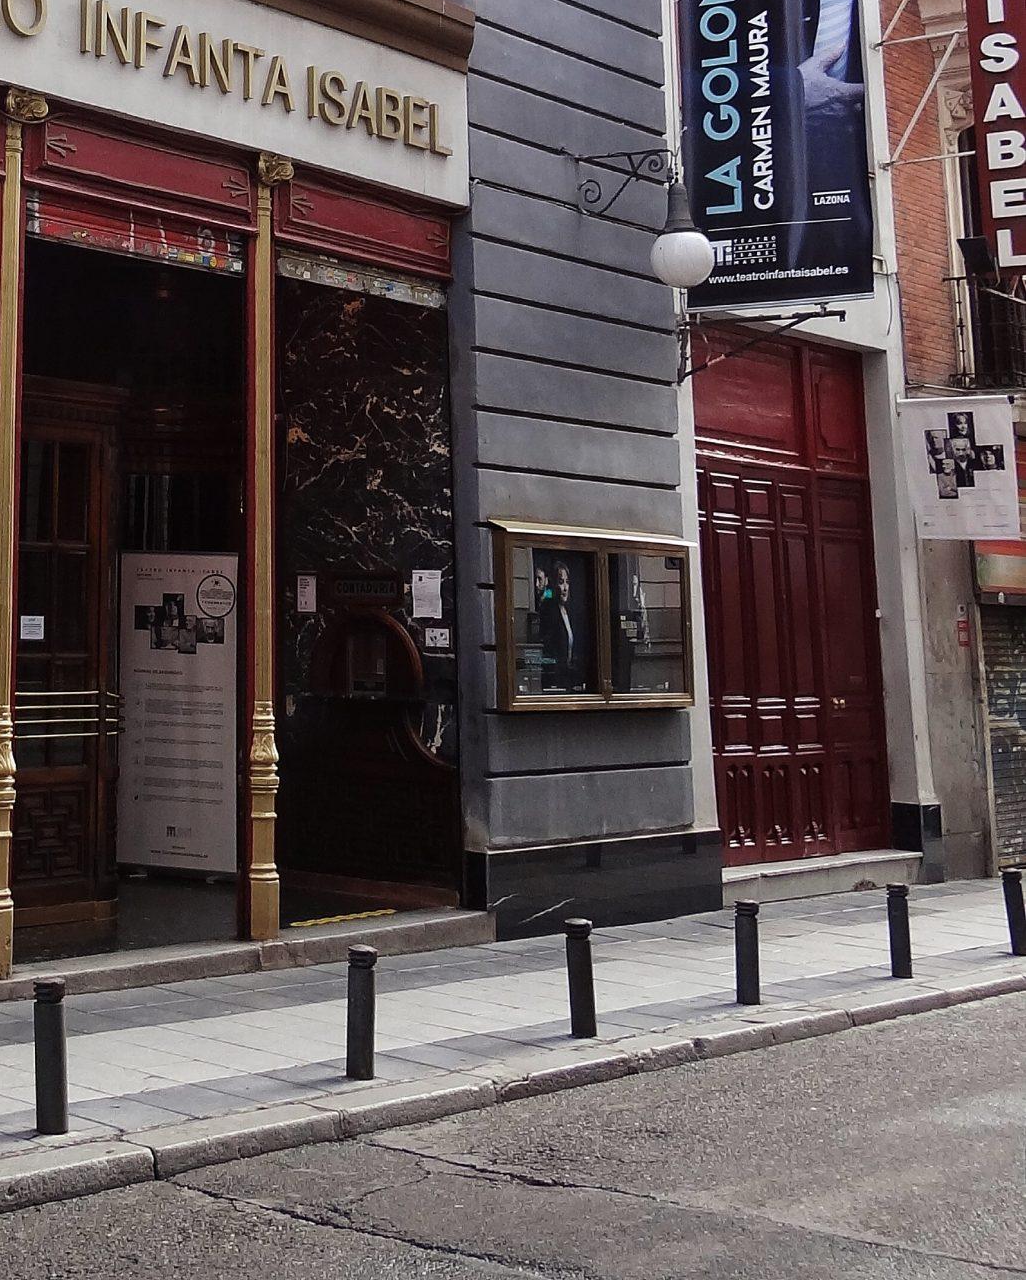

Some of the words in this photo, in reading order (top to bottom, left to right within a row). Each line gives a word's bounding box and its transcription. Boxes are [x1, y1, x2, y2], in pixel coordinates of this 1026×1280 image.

[748, 9, 769, 98] MAURA
[307, 64, 454, 159] ISABEL
[706, 155, 743, 215] LA
[752, 107, 775, 211] CARMEN
[814, 194, 851, 206] LAZONA
[708, 265, 849, 284] www.teatroinfantaisabel.es
